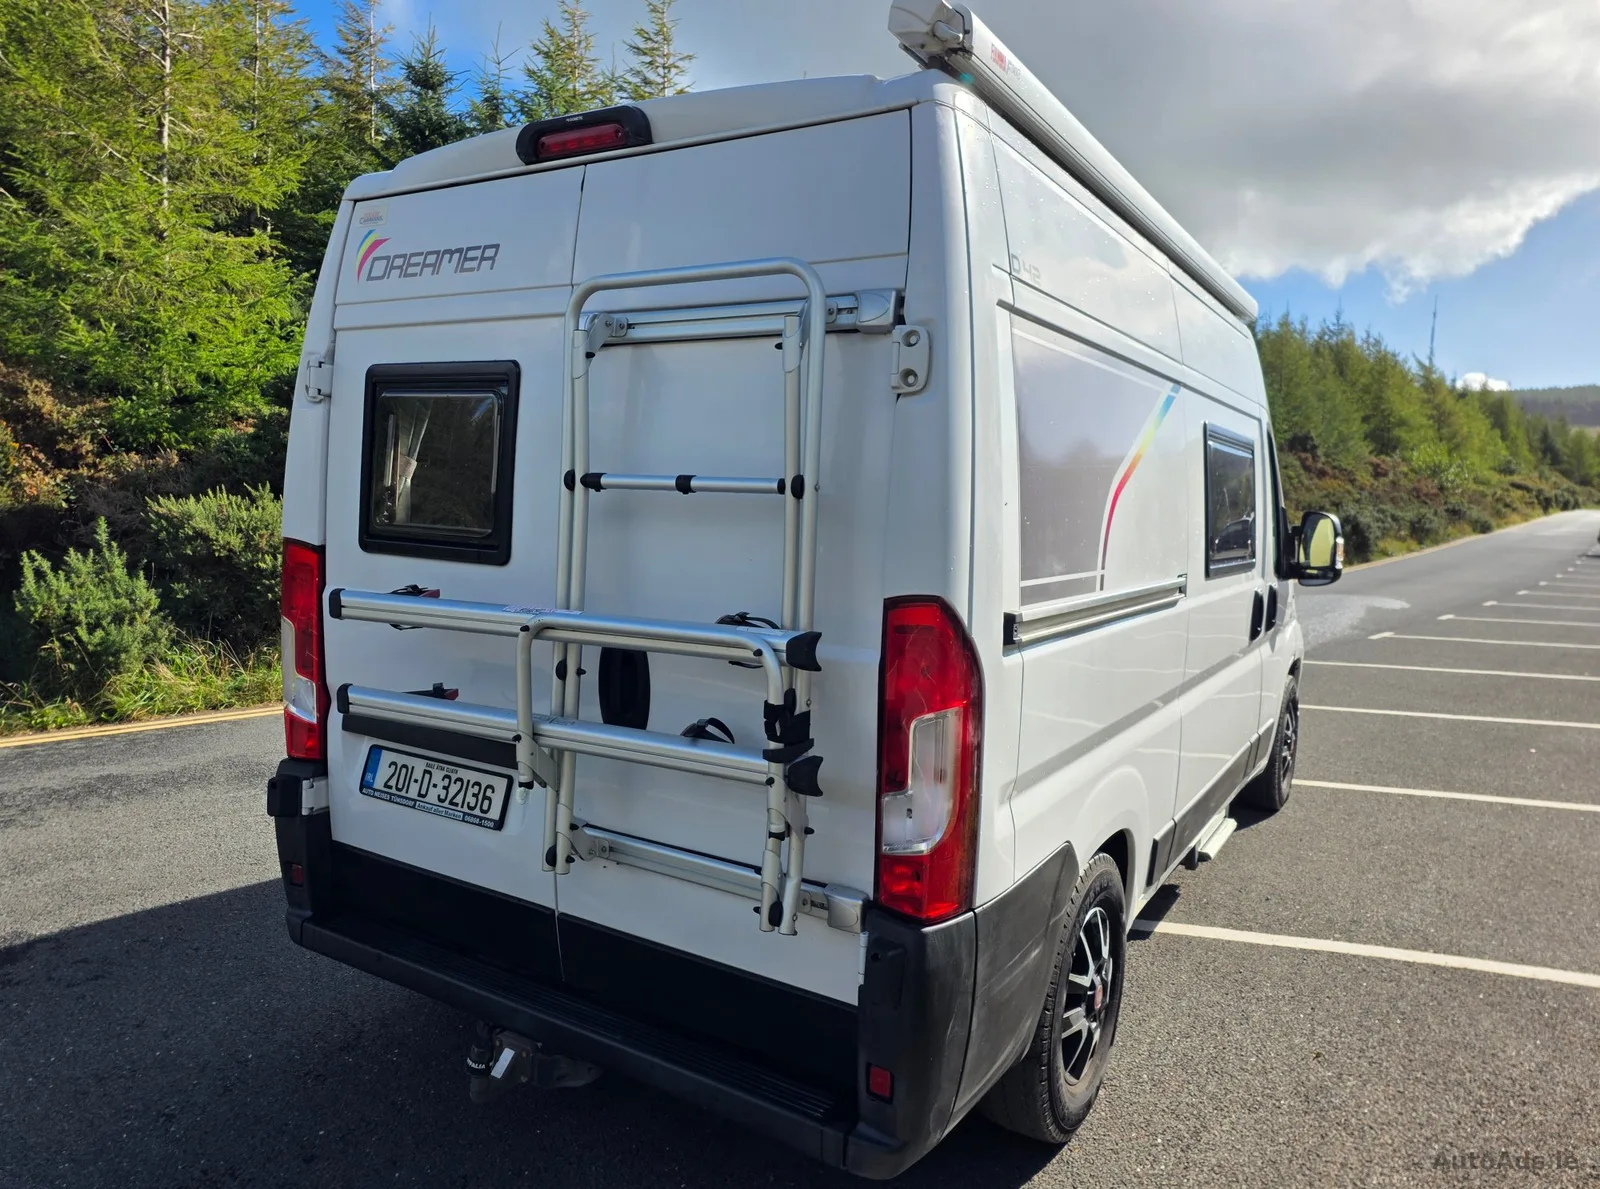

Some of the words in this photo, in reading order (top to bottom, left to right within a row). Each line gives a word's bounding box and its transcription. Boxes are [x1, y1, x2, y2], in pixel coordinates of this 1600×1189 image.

[366, 243, 500, 282] DREAMER
[383, 761, 495, 814] 201-D-32136
[417, 803, 433, 812] Ankauf
[444, 810, 462, 819] Marken
